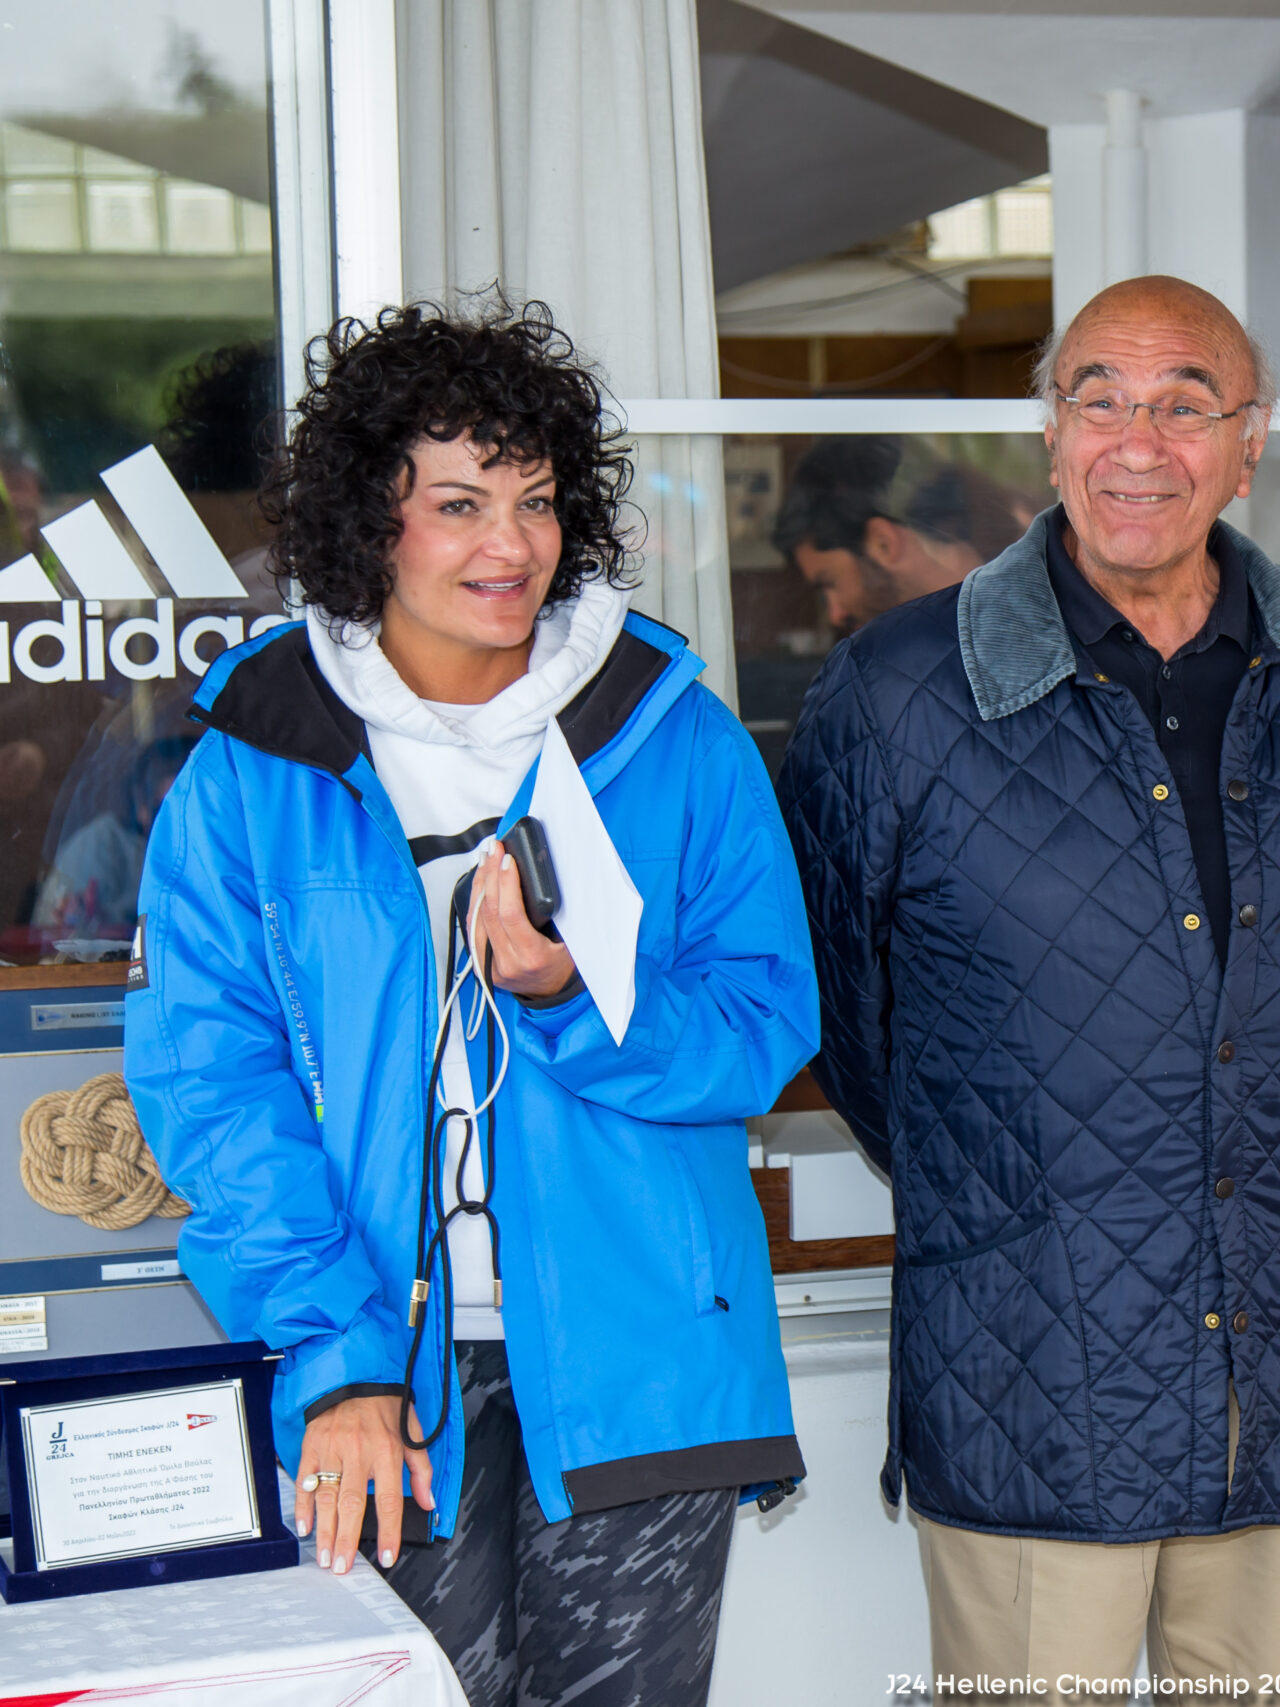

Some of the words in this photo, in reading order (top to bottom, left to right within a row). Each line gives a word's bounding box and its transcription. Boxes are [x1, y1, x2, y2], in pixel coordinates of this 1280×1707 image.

[0, 597, 291, 684] dida
[51, 1443, 67, 1455] 24
[107, 1449, 133, 1461] ΤΙΜΗΣ
[135, 1443, 172, 1456] ΕΝΕΚΕΝ
[192, 1485, 210, 1494] 2022
[170, 1503, 184, 1511] J24
